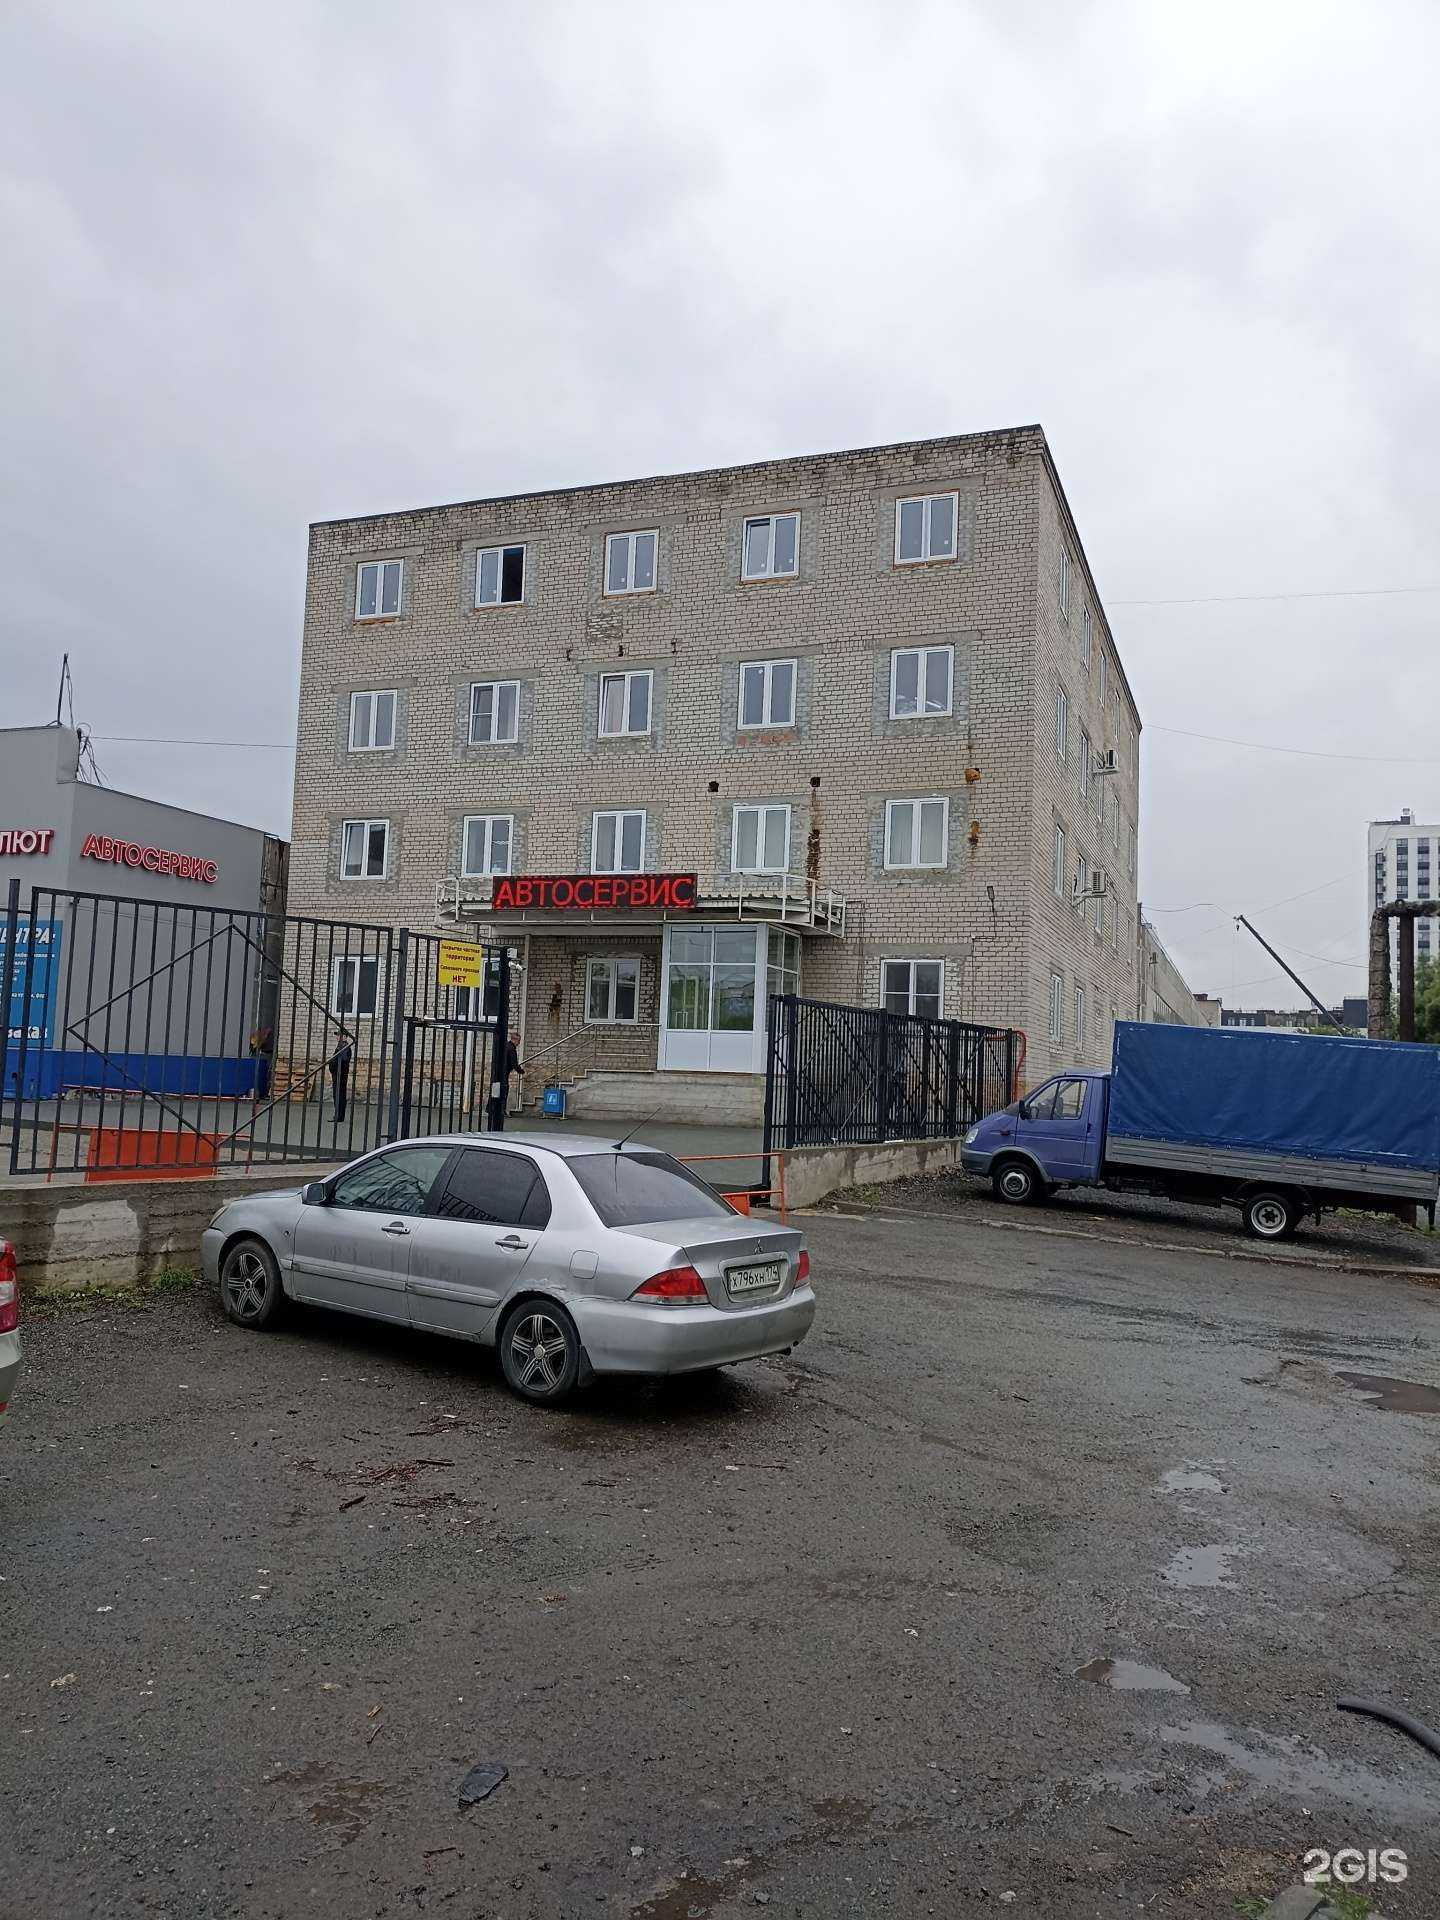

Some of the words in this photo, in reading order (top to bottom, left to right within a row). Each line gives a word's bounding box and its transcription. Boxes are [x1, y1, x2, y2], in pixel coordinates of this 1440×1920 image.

[82, 832, 218, 883] АВТОСЕРВИС
[495, 878, 692, 906] АВТОСЕРВИС
[452, 975, 467, 983] НЕТ
